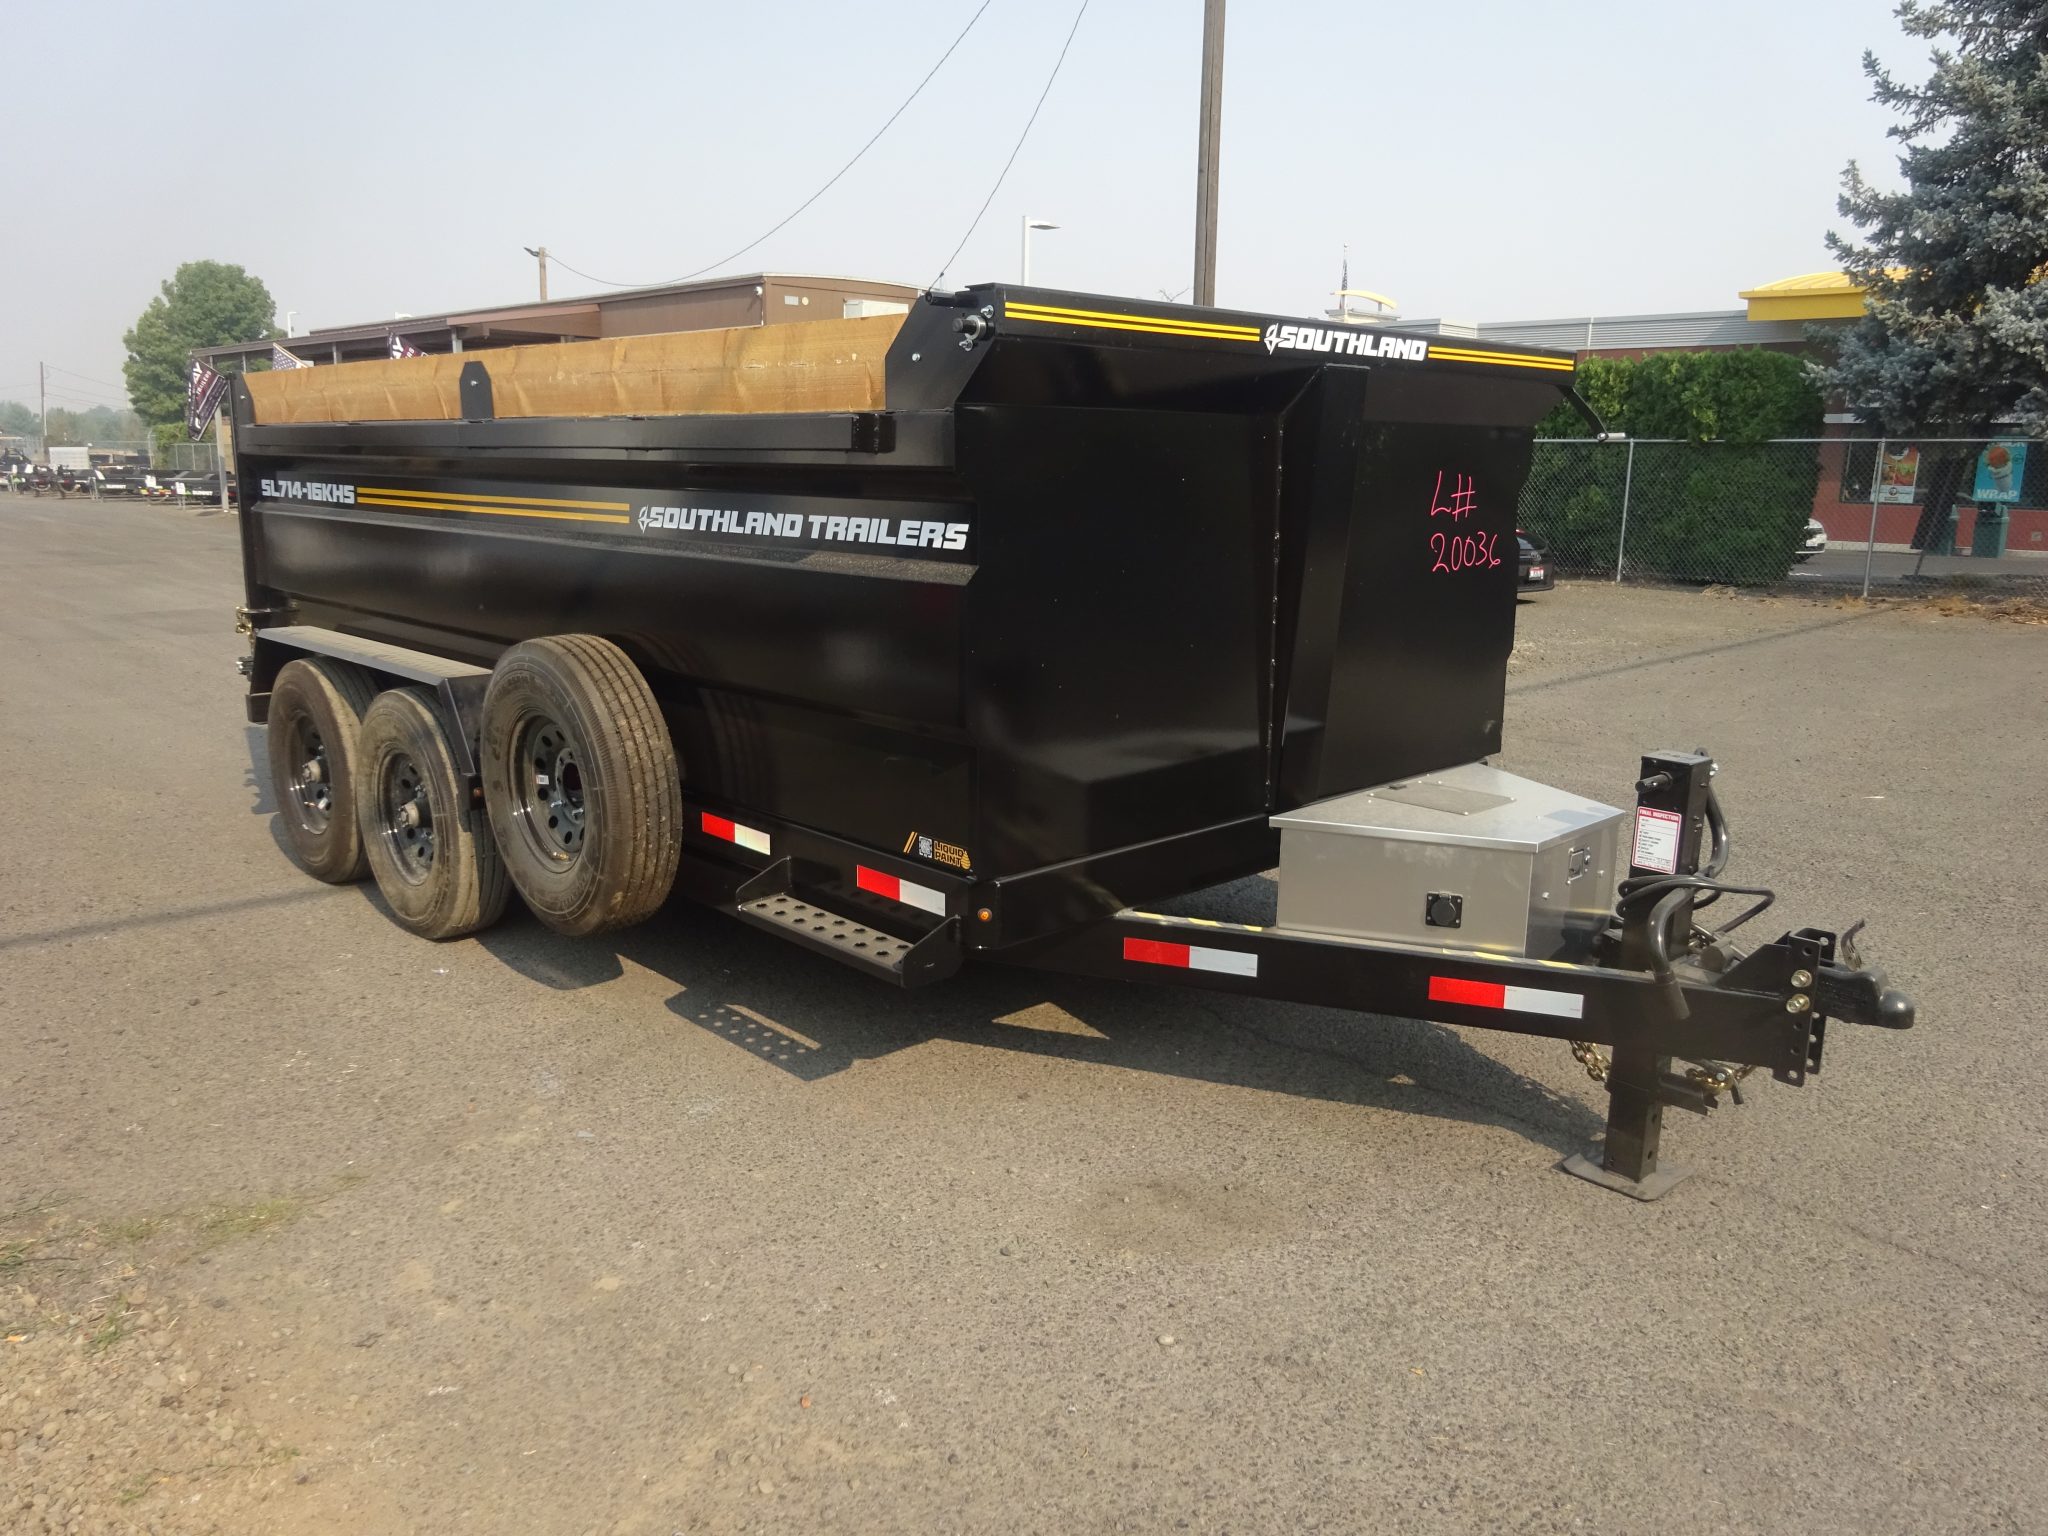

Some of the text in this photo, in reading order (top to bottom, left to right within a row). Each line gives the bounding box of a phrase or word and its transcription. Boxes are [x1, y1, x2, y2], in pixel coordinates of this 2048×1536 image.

[1277, 325, 1428, 362] SOUTHLAND
[261, 479, 355, 504] SL714-16KHS
[1430, 470, 1478, 522] L#
[649, 506, 970, 551] SOUTHLAND TRAILERS
[1430, 531, 1501, 573] 20036
[934, 841, 964, 857] LIQUID
[934, 851, 961, 867] PAINT
